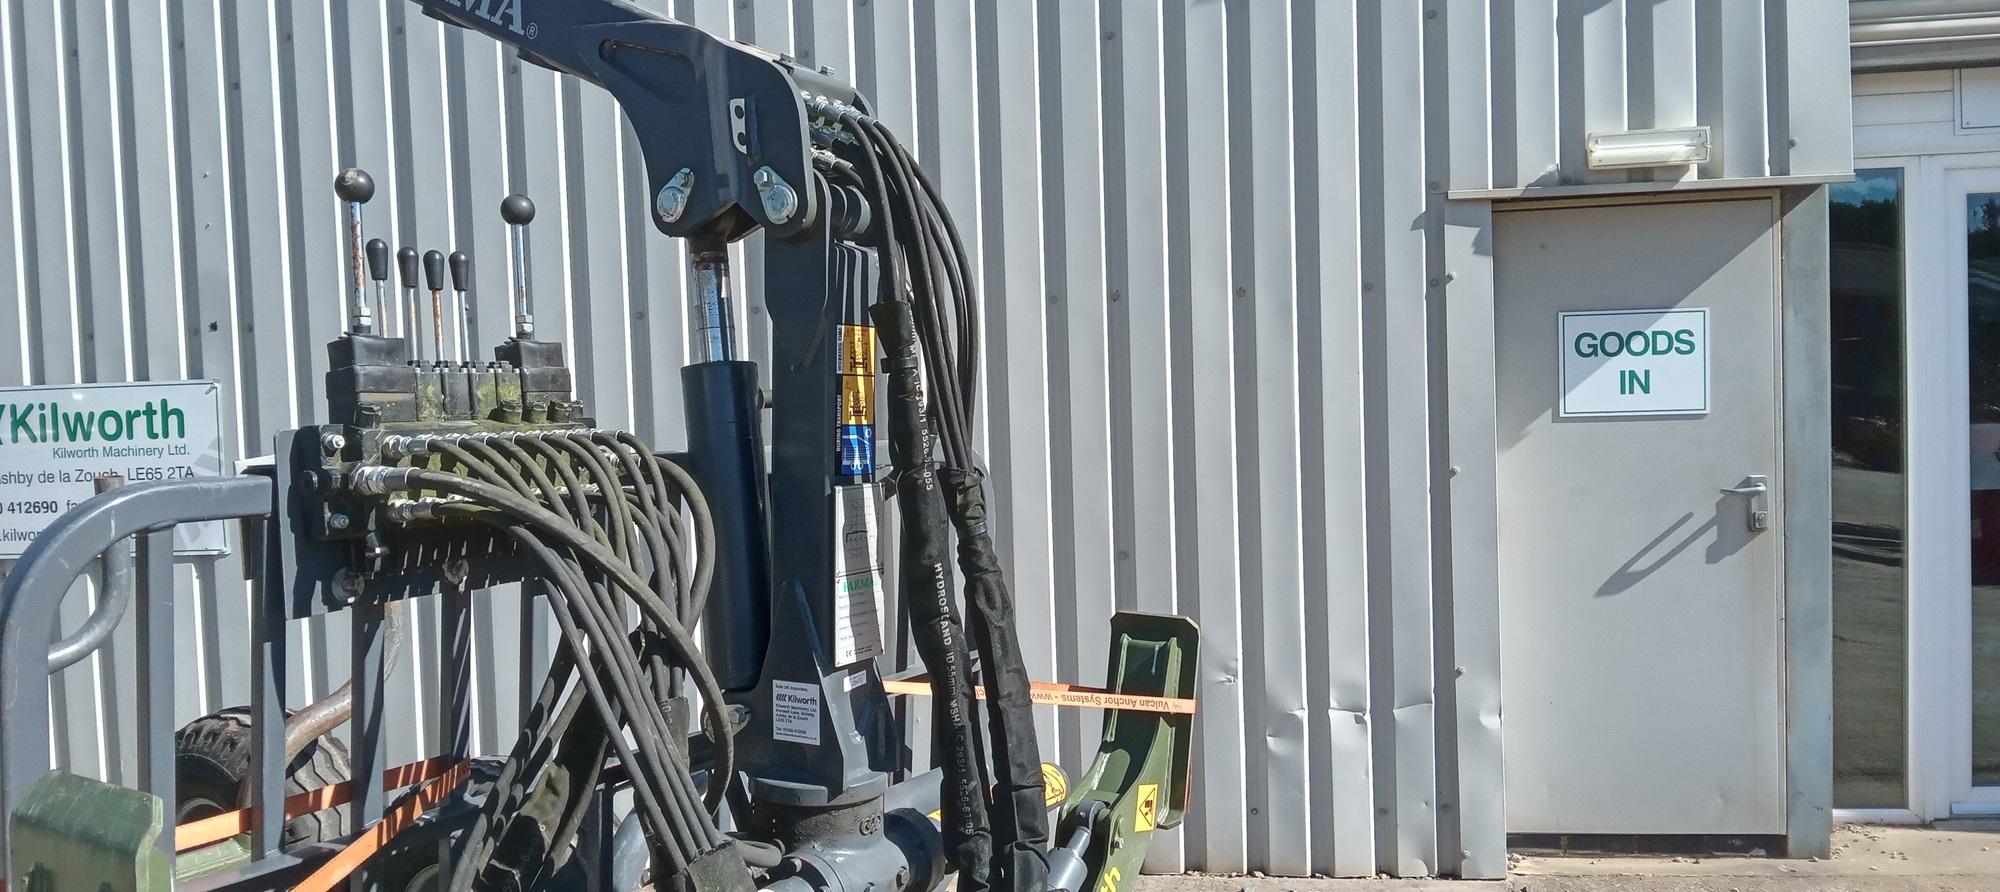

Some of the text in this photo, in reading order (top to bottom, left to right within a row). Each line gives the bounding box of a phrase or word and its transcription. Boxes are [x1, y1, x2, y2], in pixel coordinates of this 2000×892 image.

[1574, 329, 1696, 358] GOODS
[1619, 369, 1651, 395] IN
[9, 398, 186, 444] Kilworth
[52, 443, 190, 459] Kilworth Machinery Ltd.
[0, 470, 33, 487] shby
[37, 470, 55, 483] de
[59, 469, 71, 483] la
[127, 467, 163, 481] LE65
[167, 466, 195, 480] 2TA
[7, 501, 58, 514] 412690
[788, 694, 817, 706] Kilworth
[1061, 694, 1102, 706] Systems
[1103, 697, 1138, 708] Anchor
[1139, 699, 1170, 710] Vulcan
